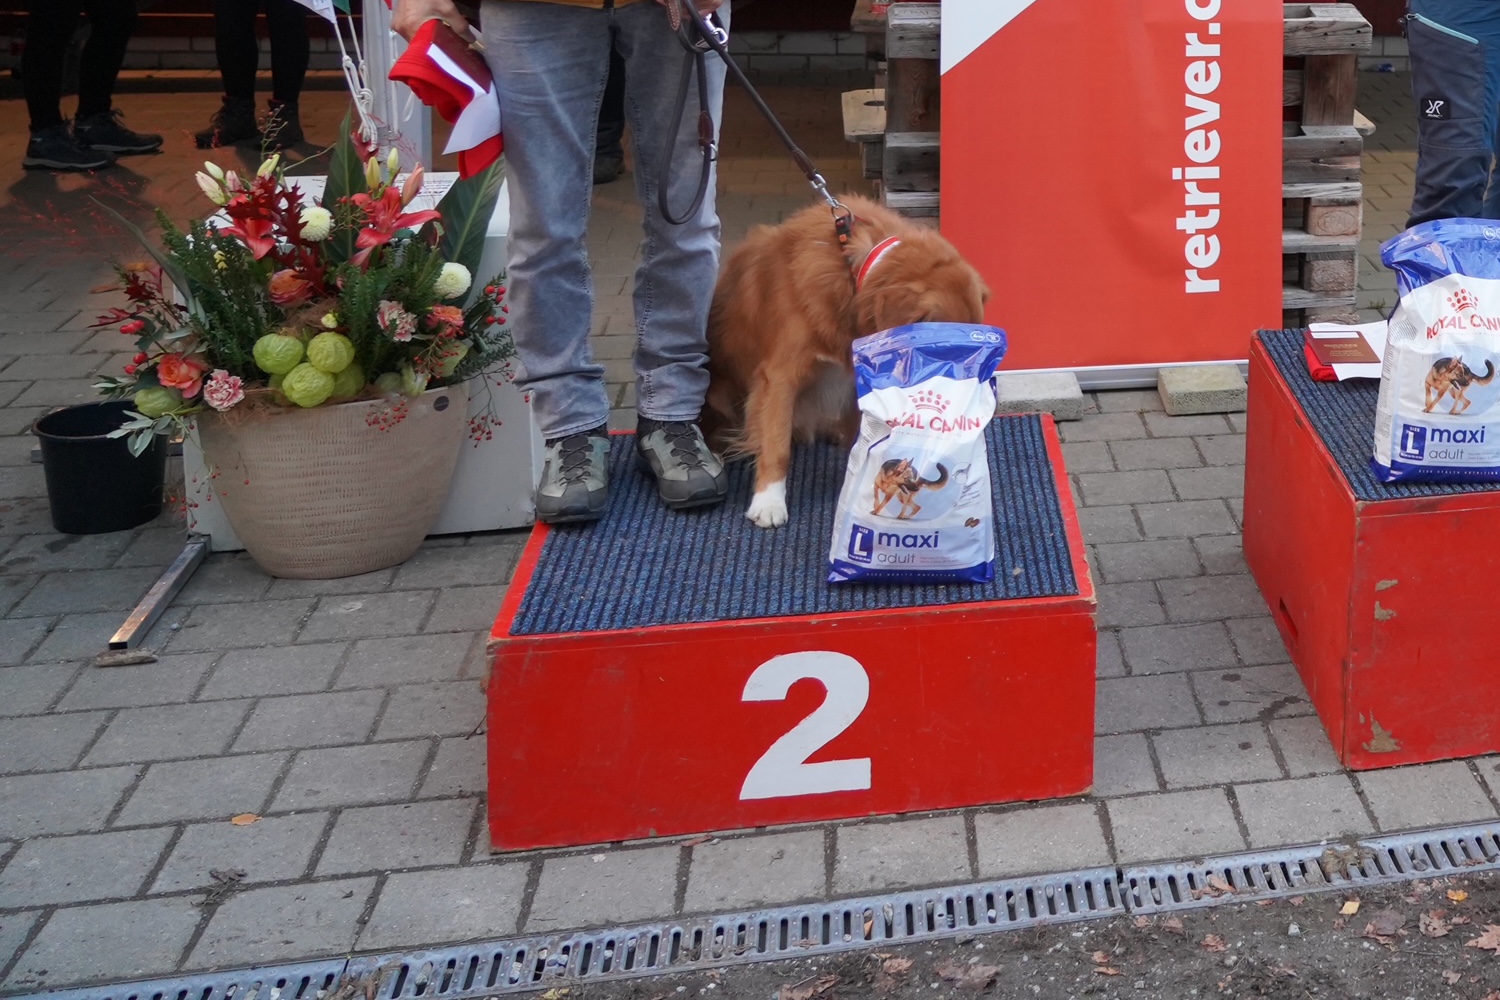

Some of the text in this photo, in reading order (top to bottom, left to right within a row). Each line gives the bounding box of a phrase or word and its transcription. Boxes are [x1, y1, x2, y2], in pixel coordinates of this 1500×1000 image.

[1426, 316, 1467, 340] ROYAL
[930, 415, 980, 434] CANIN
[1406, 430, 1419, 455] L
[1430, 426, 1485, 443] maxi
[1429, 449, 1464, 459] adult
[853, 532, 867, 557] L
[878, 531, 939, 548] maxi
[877, 553, 916, 564] adult
[739, 651, 872, 800] 2
